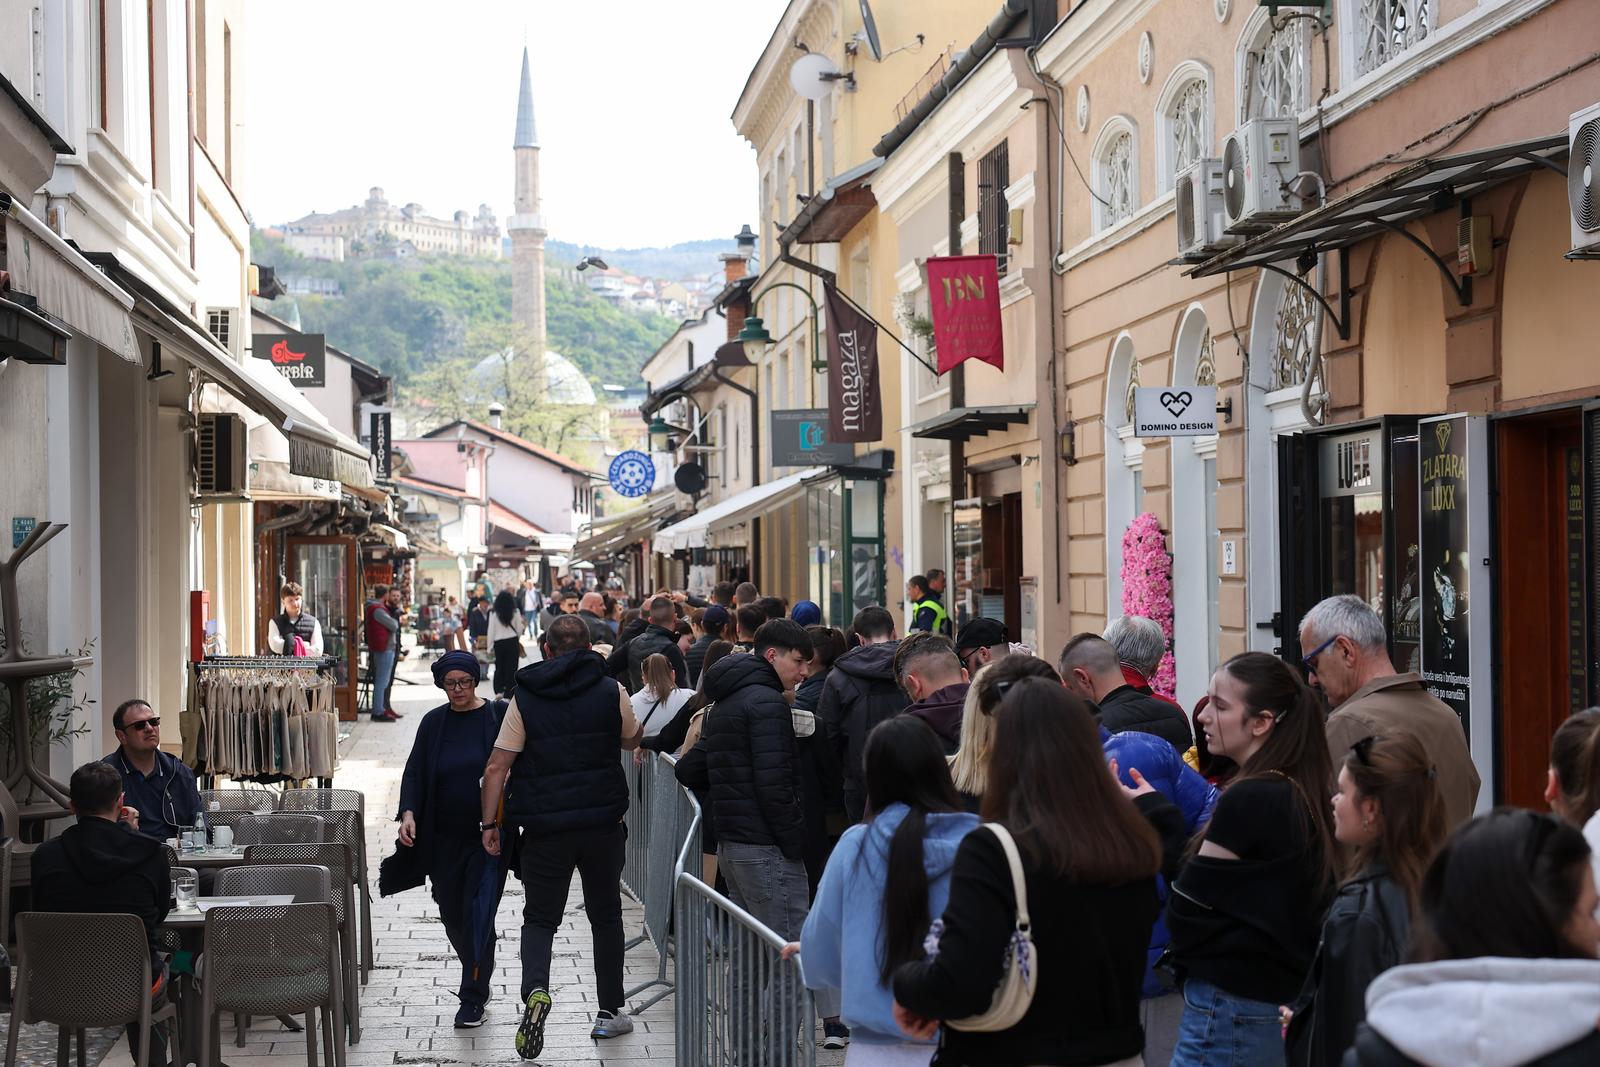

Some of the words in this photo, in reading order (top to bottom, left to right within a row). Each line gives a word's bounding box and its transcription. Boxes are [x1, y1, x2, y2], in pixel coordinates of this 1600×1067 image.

[838, 330, 864, 432] magaza
[1141, 423, 1177, 431] DOMINO
[1180, 422, 1214, 430] DESIGN
[1424, 454, 1465, 484] ZLATARA
[1431, 485, 1455, 511] LUXX
